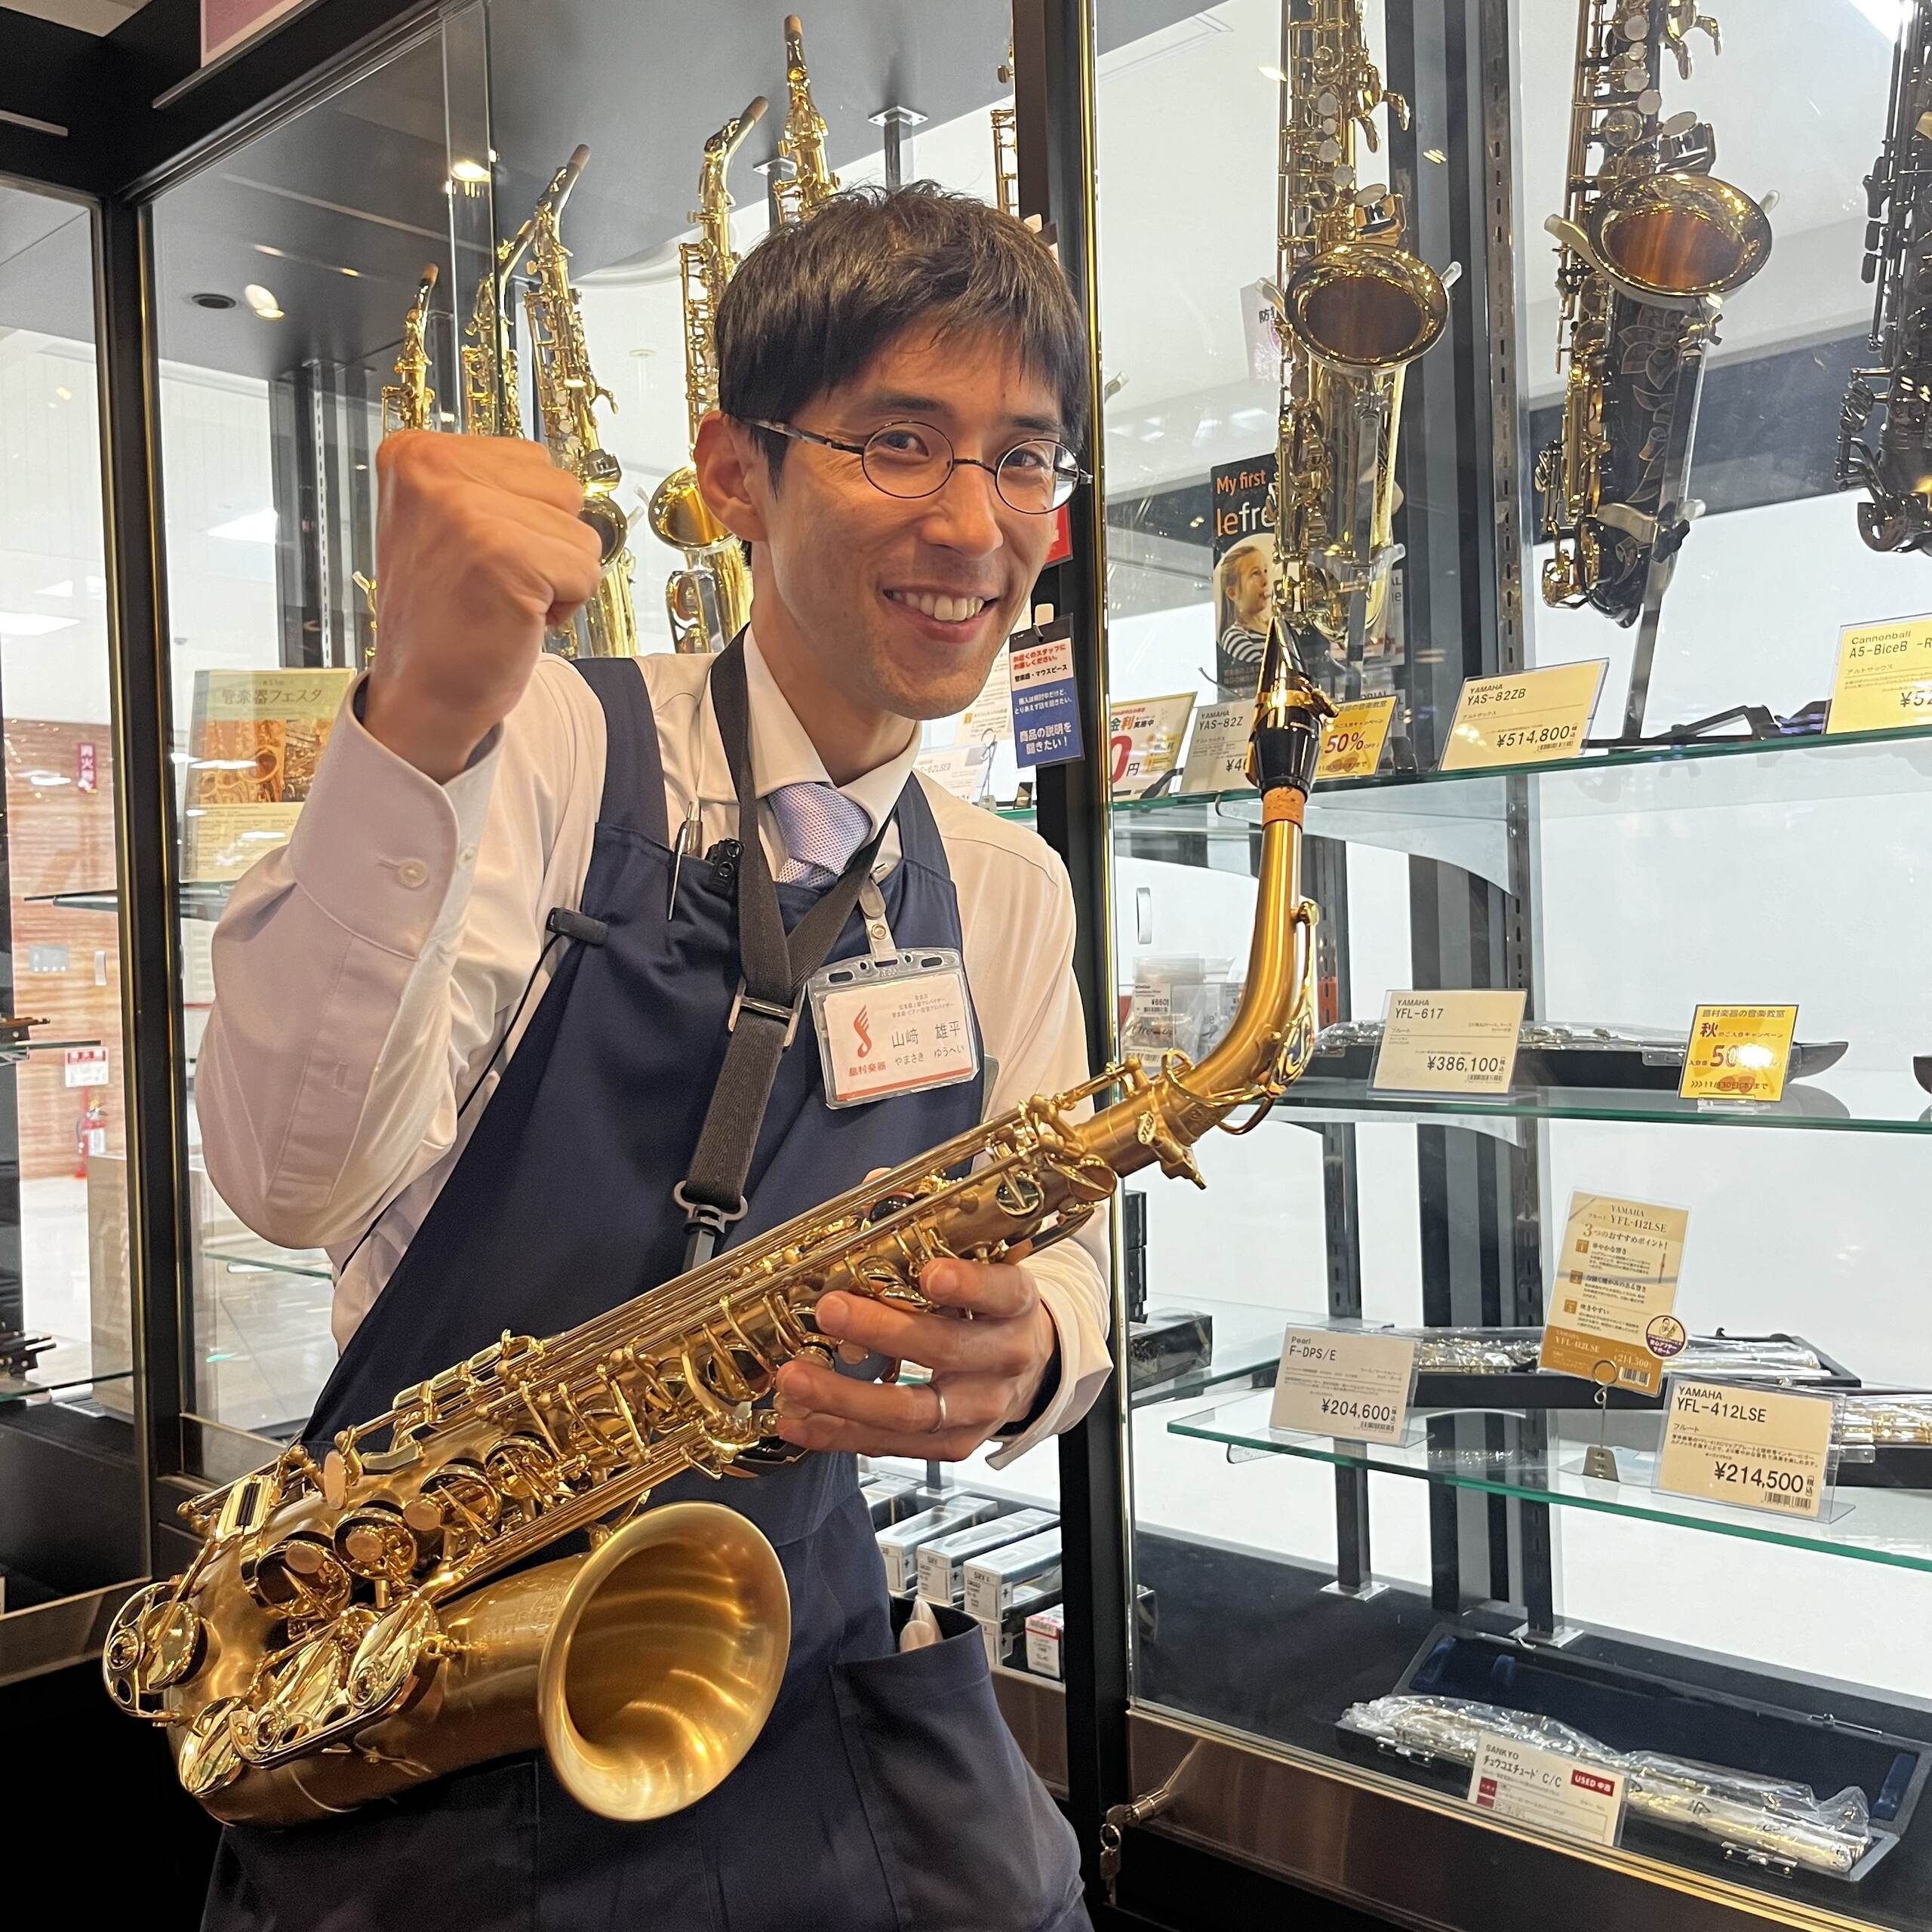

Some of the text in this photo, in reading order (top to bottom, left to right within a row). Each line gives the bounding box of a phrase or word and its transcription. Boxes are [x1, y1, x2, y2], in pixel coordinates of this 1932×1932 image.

[1216, 469, 1266, 496] My first
[1851, 630, 1912, 645] Cannonball
[1849, 641, 1908, 659] A5-BiceB
[222, 688, 322, 705] 管楽器フェスタ
[1467, 688, 1527, 706] YAS-82ZB
[1471, 684, 1503, 694] YAMAHA
[1201, 710, 1229, 719] YAMAHA
[1199, 716, 1244, 731] YAS-82Z
[1020, 721, 1072, 743] 商品の説明を
[1497, 724, 1571, 748] ¥514,800
[1324, 731, 1366, 754] 50%
[1395, 1008, 1444, 1019] YFL-617
[934, 1020, 961, 1040] 雄平
[894, 1044, 965, 1066] やまさき ゆうへい
[848, 1060, 887, 1077] 島村楽器
[1426, 1056, 1499, 1072] ¥386,100
[1611, 1204, 1644, 1217] YAMAHA
[1611, 1214, 1667, 1233] YFL-412LSE
[1291, 1336, 1312, 1345] Pearl
[1289, 1345, 1337, 1361] F-DPS/E
[1678, 1386, 1723, 1401] YAMAHA
[1321, 1398, 1391, 1422] ¥204,600
[1676, 1396, 1767, 1423] YFL-412LSE
[1672, 1423, 1700, 1432] フルート
[1714, 1460, 1804, 1494] ¥214,500
[1485, 1744, 1519, 1760] SANKYO
[1542, 1773, 1562, 1788] C/C
[1574, 1774, 1596, 1788] USED
